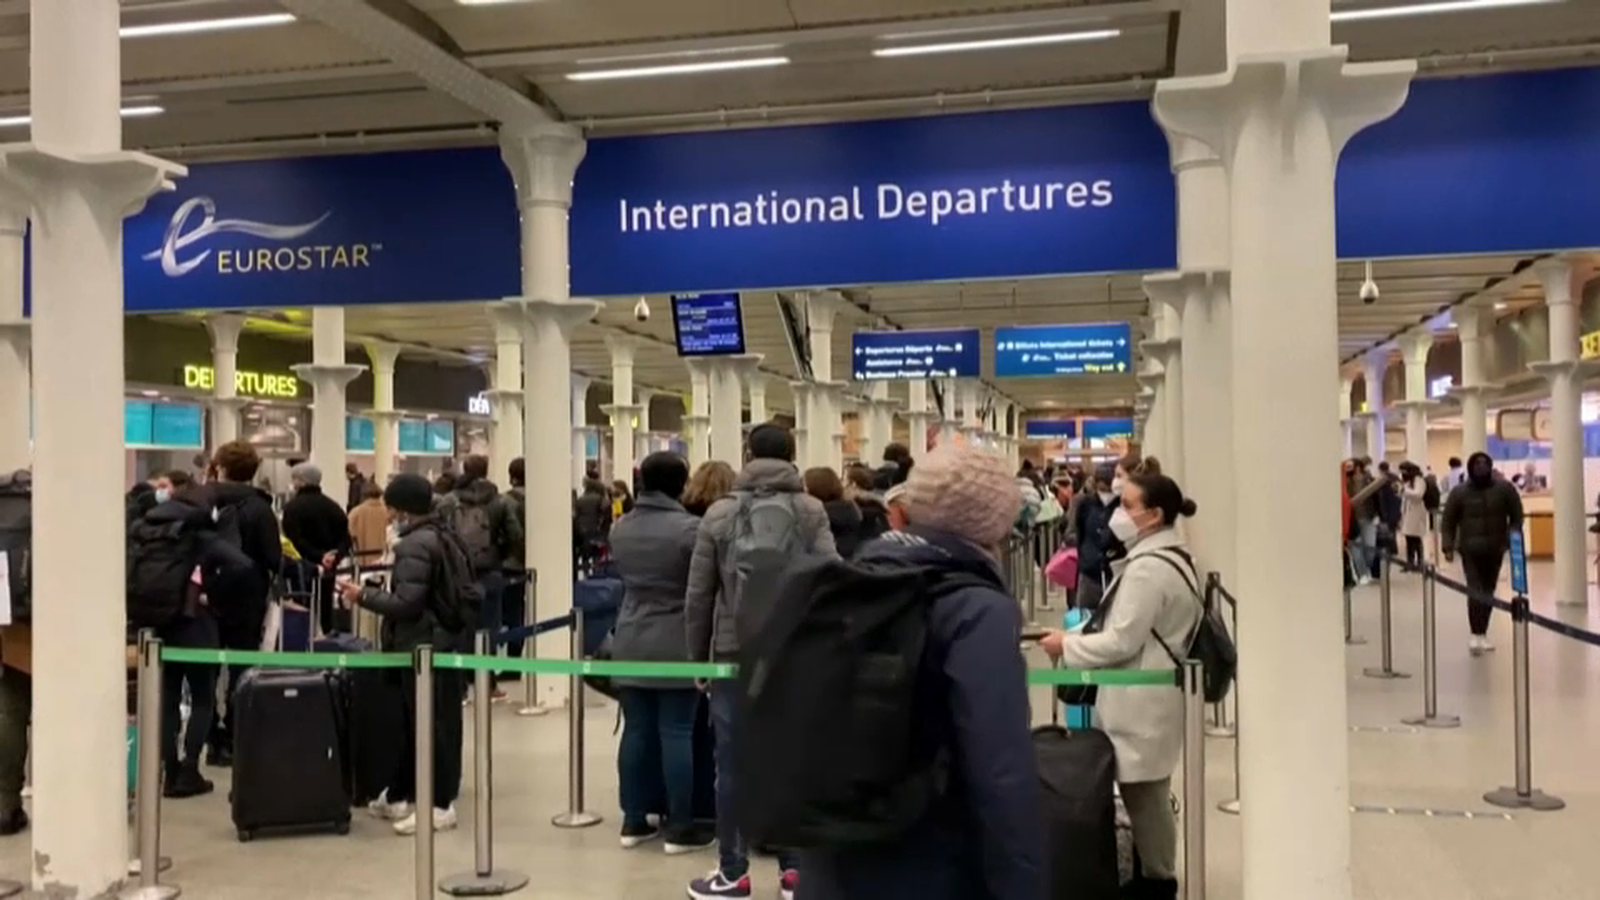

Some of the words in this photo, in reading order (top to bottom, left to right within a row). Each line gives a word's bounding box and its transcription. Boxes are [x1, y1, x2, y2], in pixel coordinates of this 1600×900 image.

[619, 186, 864, 232] International
[877, 178, 1114, 225] Departures
[184, 364, 298, 397] DERTURES
